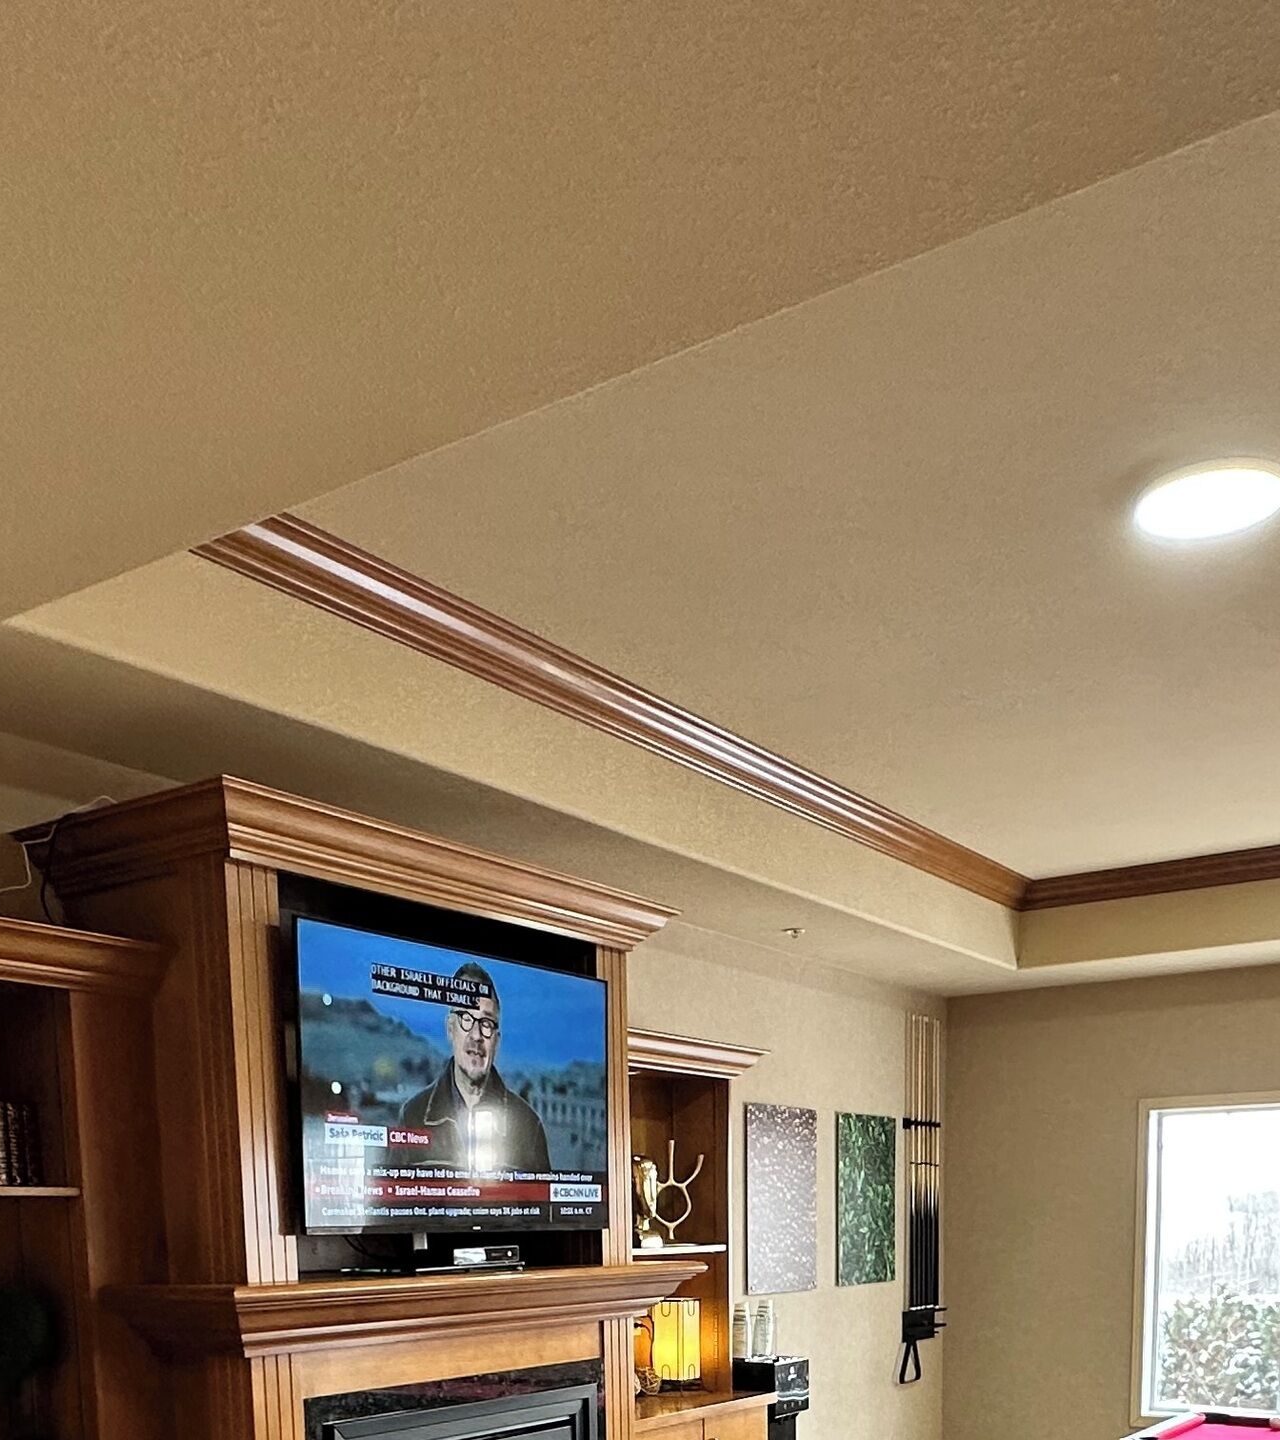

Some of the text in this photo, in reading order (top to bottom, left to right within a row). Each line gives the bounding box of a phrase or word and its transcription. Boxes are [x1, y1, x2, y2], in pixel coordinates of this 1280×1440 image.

[371, 964, 396, 978] OTHER
[401, 969, 432, 984] ISRAELI
[436, 975, 476, 992] OFFICIALS
[371, 979, 420, 996] BACKGROUND
[423, 988, 441, 1001] THAT
[389, 1131, 429, 1144] CBC News
[373, 1167, 399, 1178] mix-up
[400, 1169, 415, 1179] may
[416, 1168, 433, 1178] have
[434, 1168, 445, 1178] led
[446, 1170, 454, 1178] to
[395, 1185, 445, 1196] Israel-Hamas
[446, 1186, 480, 1197] Ceasefire
[560, 1188, 599, 1198] CBCNN LIVE
[428, 1207, 445, 1217] plant
